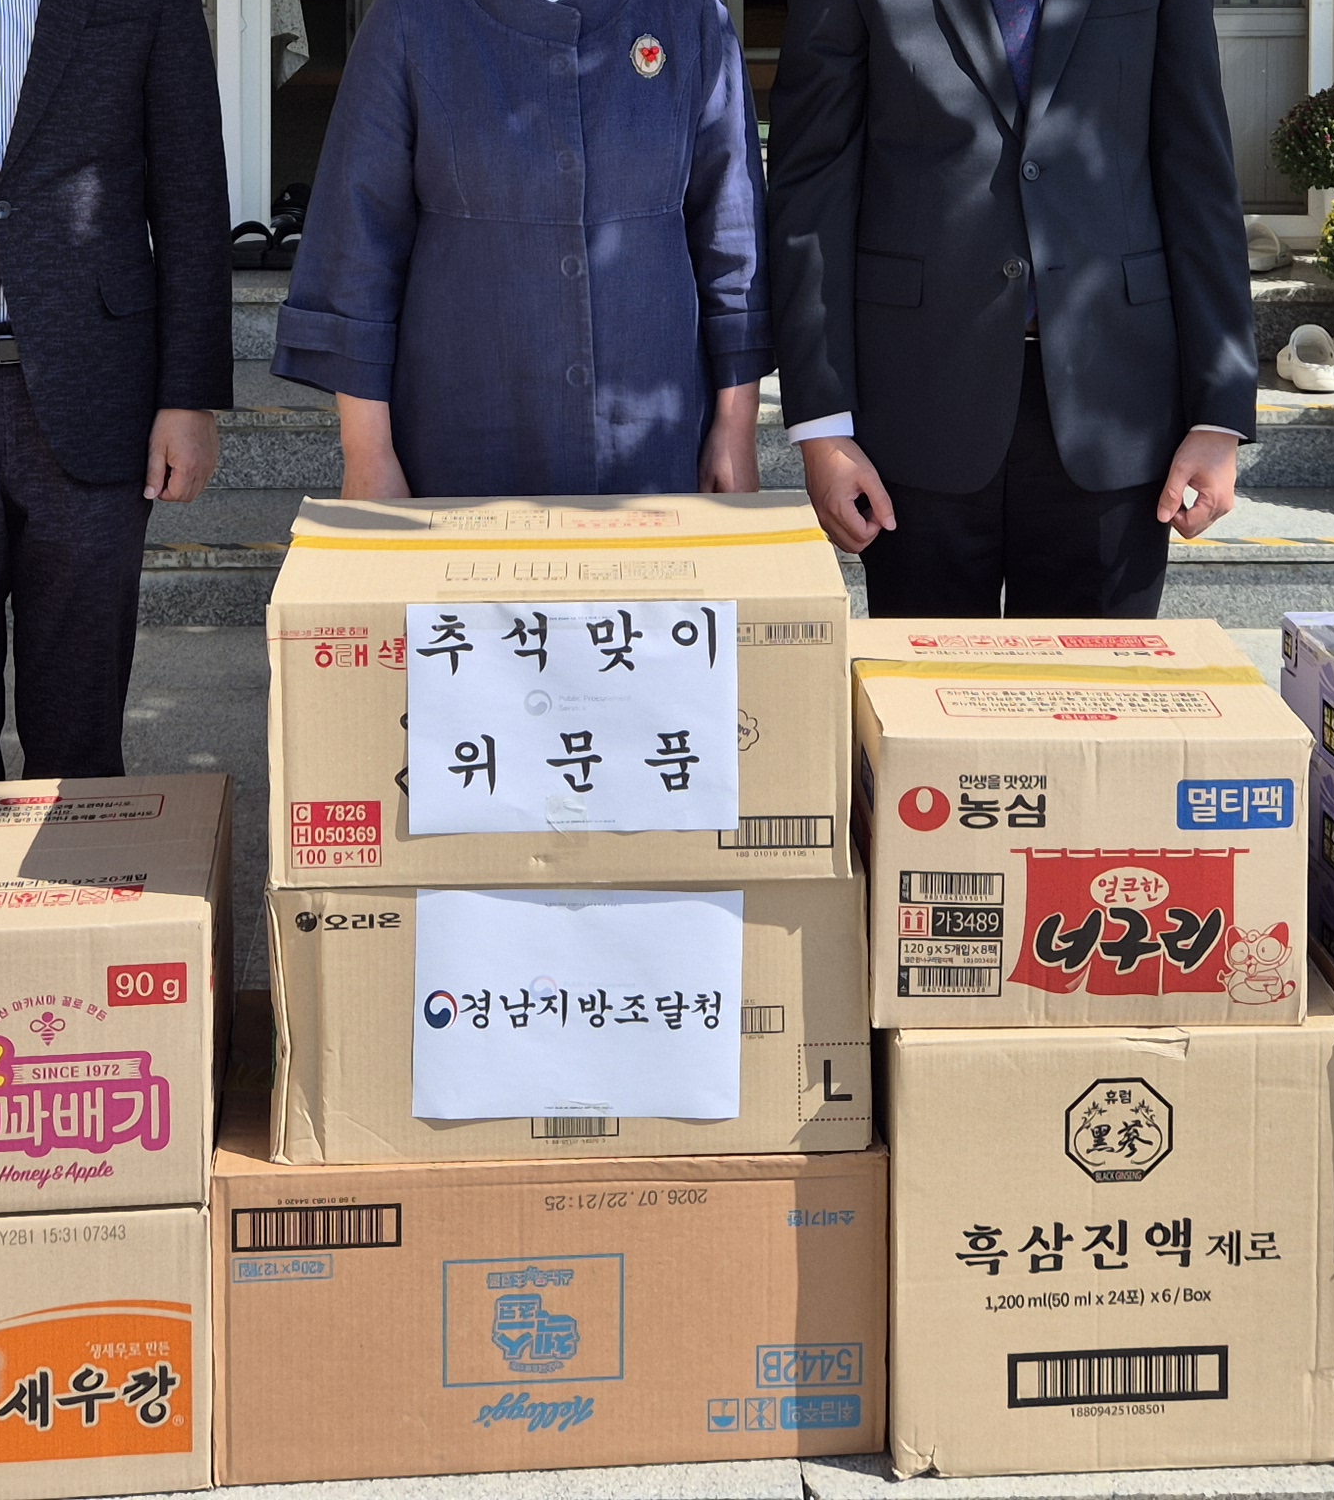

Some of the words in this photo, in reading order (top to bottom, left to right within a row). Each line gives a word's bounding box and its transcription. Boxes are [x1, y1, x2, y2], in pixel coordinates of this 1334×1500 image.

[314, 627, 346, 637] 크라운
[959, 775, 1000, 789] 인생을
[1004, 775, 1047, 790] 맛있게
[296, 806, 308, 821] C
[325, 805, 366, 821] 7826
[958, 793, 1047, 828] 농심
[1188, 785, 1283, 823] 멀티팩
[296, 827, 309, 843] H
[315, 826, 377, 843] 050369
[1097, 876, 1164, 904] 얼큰한
[323, 912, 402, 931] 오리온
[935, 911, 999, 933] 가3489
[1036, 907, 1223, 972] 너구리
[116, 971, 154, 998] 90
[162, 976, 181, 1001] g
[460, 989, 723, 1030] 경남지방조달청
[32, 1066, 79, 1080] SINCE
[85, 1064, 120, 1077] 1972
[824, 1059, 853, 1102] L
[1104, 1089, 1131, 1104] 휴럼
[1095, 1172, 1115, 1181] BLACK
[1115, 1171, 1142, 1180] GINSENG
[786, 1208, 855, 1227] 소비기한
[0, 1230, 35, 1247] Y2B1
[41, 1227, 78, 1244] 15:31
[83, 1224, 127, 1243] 07343
[955, 1217, 1192, 1276] 흑삼진액
[1205, 1230, 1281, 1266] 제로
[985, 1295, 1024, 1312] 1,200
[1075, 1291, 1091, 1306] ml
[1108, 1288, 1145, 1306] 24포)
[499, 1303, 539, 1320] 초코
[146, 1340, 170, 1357] 만든
[763, 1348, 854, 1383] 5442B
[473, 1392, 595, 1432] Kellogg's
[786, 1401, 854, 1424] 취급주의
[1070, 1404, 1166, 1418] 18809425108501
